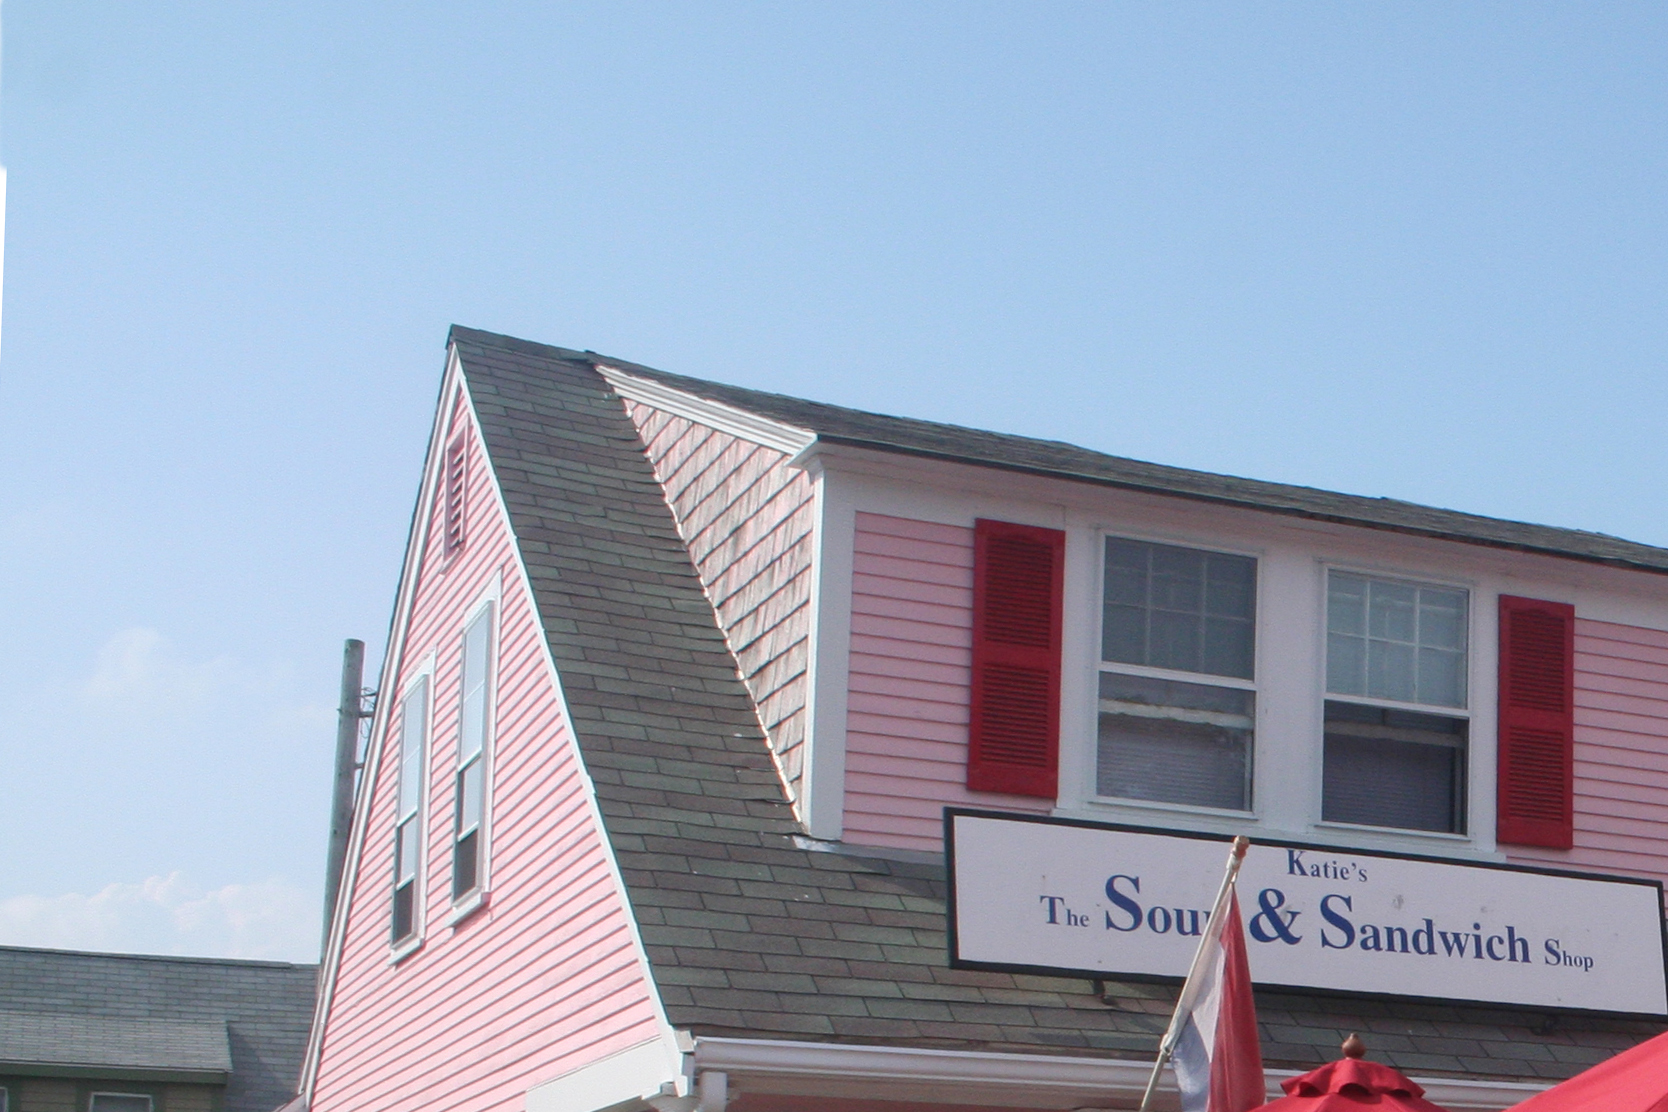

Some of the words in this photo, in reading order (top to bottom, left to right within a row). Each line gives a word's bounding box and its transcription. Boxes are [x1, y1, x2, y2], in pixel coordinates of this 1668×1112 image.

[1286, 848, 1369, 883] Katie's
[1040, 895, 1090, 928] The
[1105, 874, 1213, 937] Sou
[1249, 887, 1304, 945] &
[1320, 894, 1532, 965] Sandwich
[1544, 938, 1595, 972] Shop
